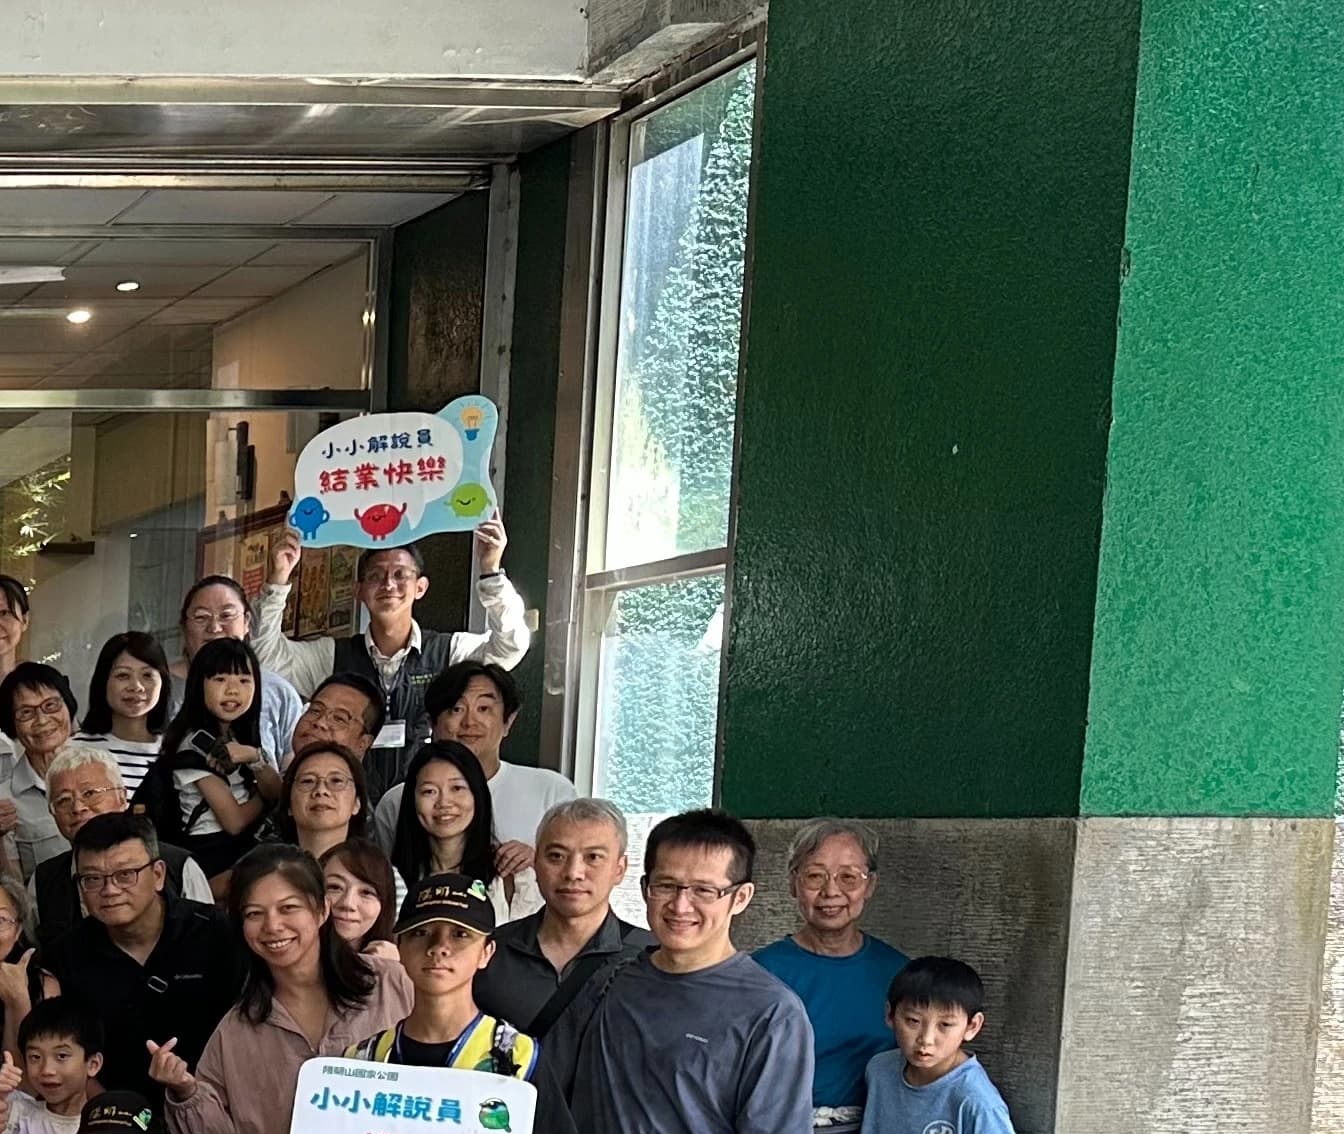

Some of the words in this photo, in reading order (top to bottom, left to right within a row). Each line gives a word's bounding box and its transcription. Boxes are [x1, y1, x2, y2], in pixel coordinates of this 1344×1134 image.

[321, 429, 434, 460] 小小解說員
[319, 456, 447, 495] 結業快樂
[310, 1087, 462, 1124] 小小解說員
